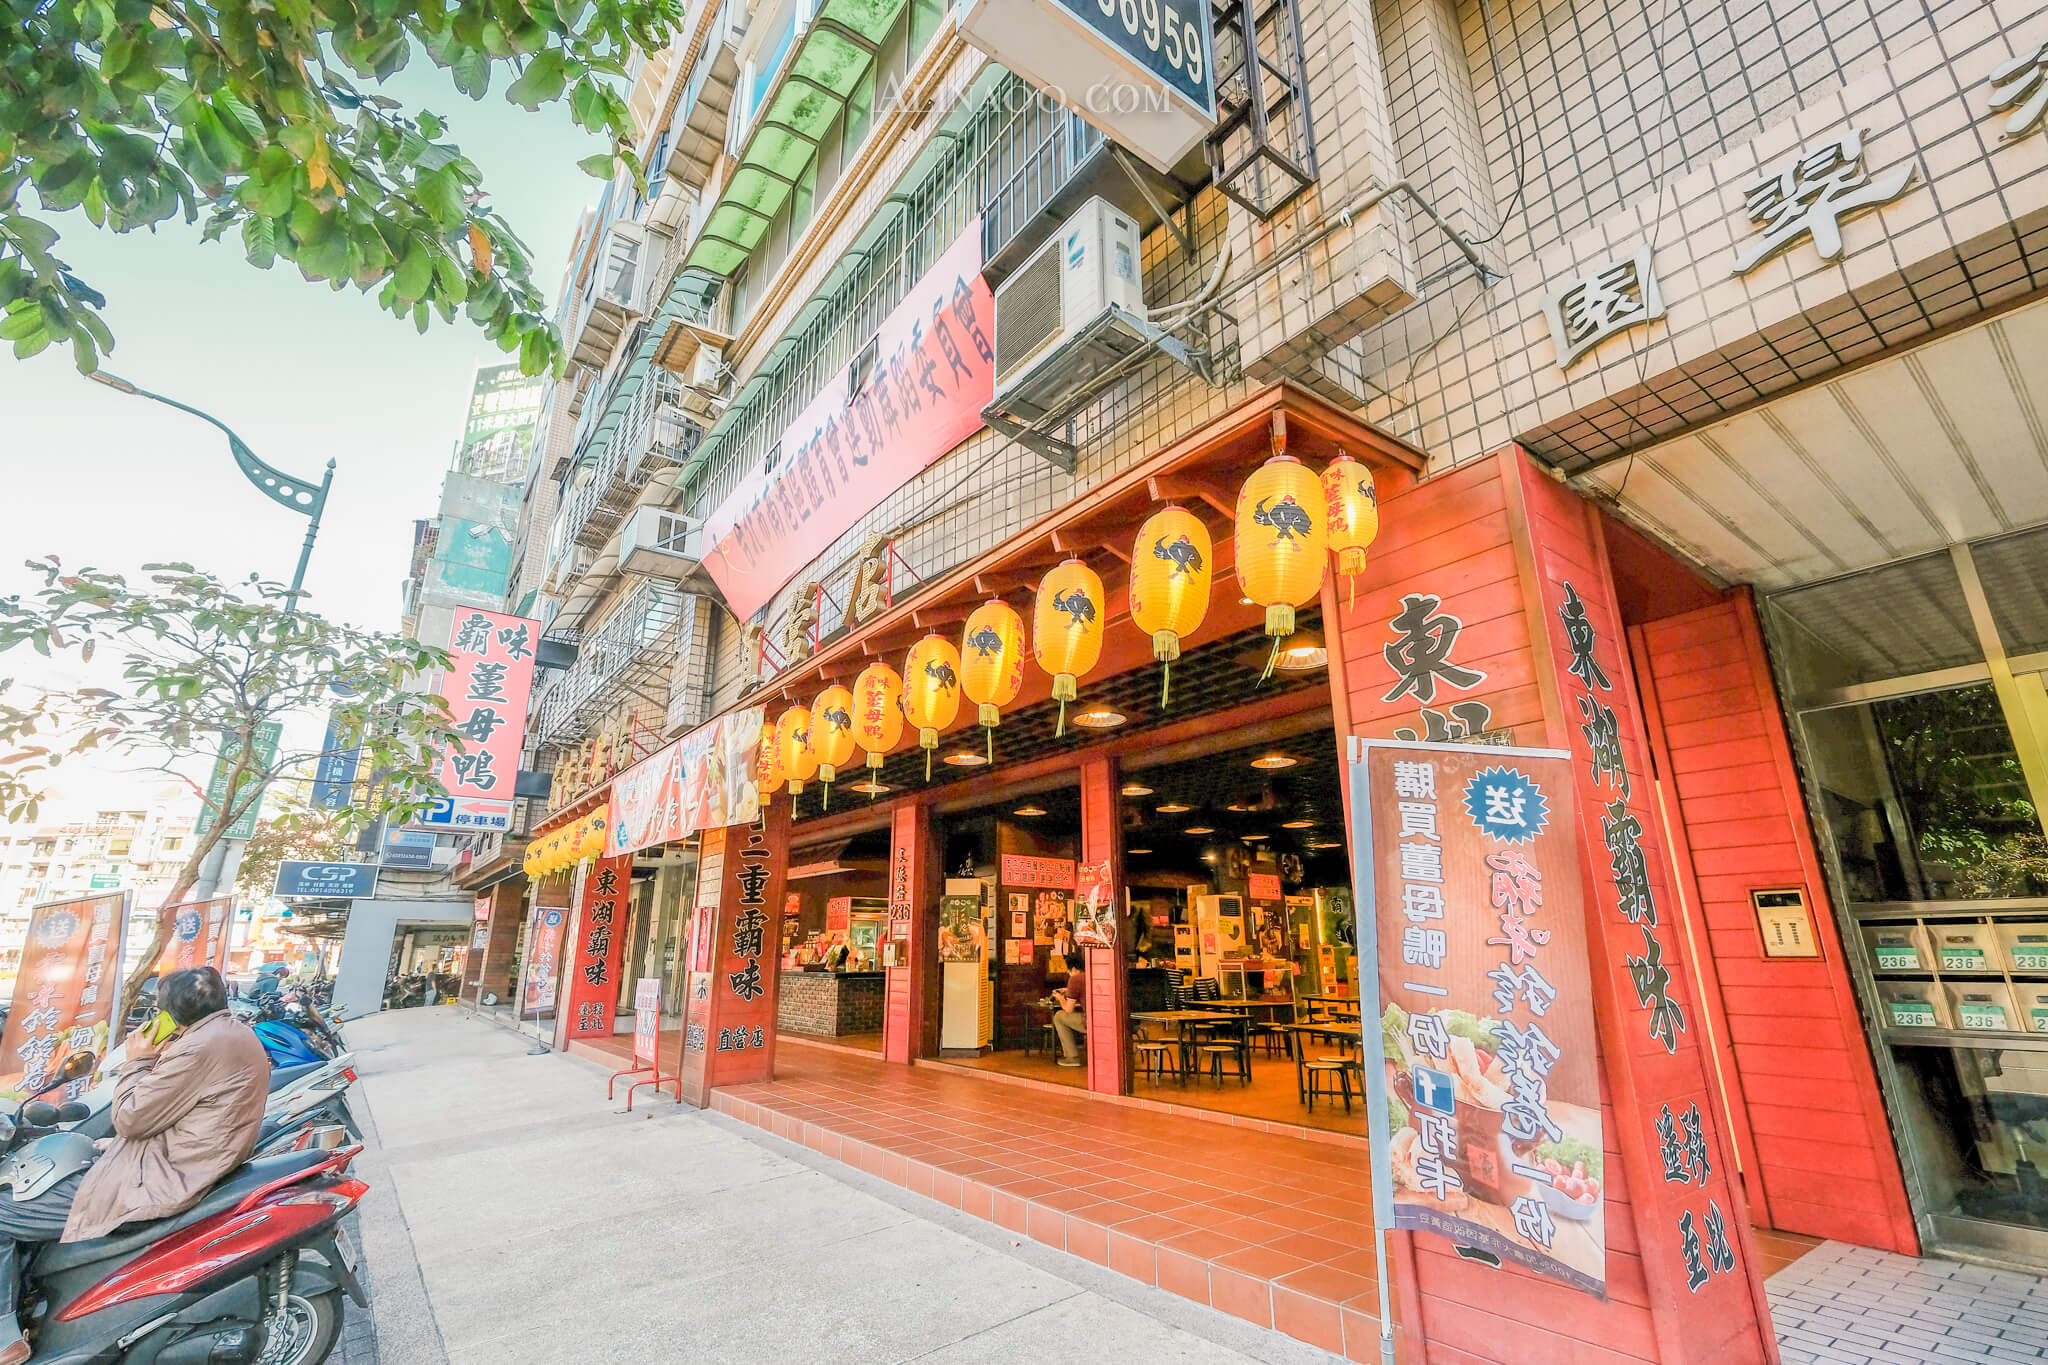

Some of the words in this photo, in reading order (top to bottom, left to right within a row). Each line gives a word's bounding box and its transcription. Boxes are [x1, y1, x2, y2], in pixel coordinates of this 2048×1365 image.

[453, 613, 534, 662] 霸味
[451, 662, 509, 792] 薑母鴨
[455, 814, 506, 828] 停車場
[1558, 580, 1687, 1055] 東湖霸味
[302, 866, 357, 882] CSP
[891, 903, 911, 920] 236
[584, 867, 619, 987] 東湖霸味
[1881, 956, 1907, 967] 236
[1946, 957, 1974, 969] 236
[1896, 1013, 1923, 1024] 236
[1965, 1015, 1993, 1027] 236
[716, 1024, 765, 1053] 直營店
